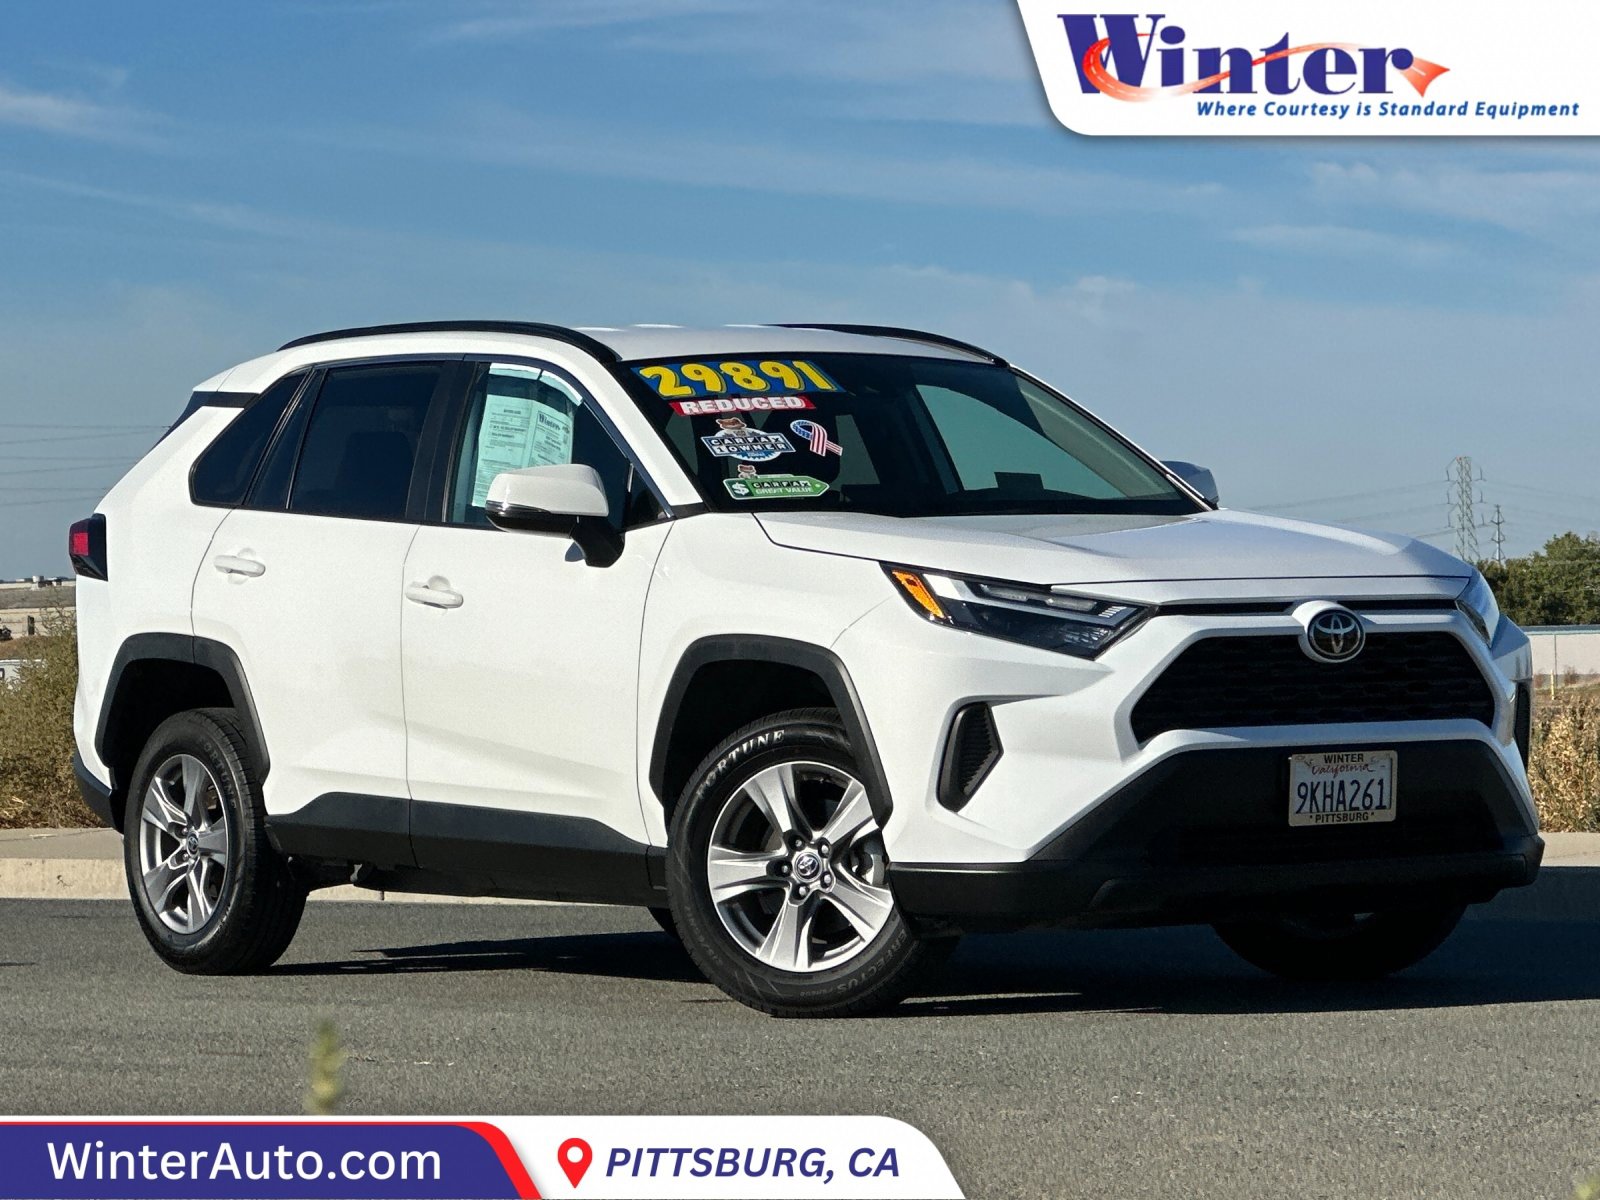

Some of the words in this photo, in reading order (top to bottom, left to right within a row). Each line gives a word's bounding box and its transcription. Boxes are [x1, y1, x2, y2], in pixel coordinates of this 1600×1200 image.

[639, 360, 838, 397] 29891
[679, 396, 807, 415] REDUCED
[711, 435, 785, 446] CARFAX
[753, 480, 811, 489] CARFAX
[784, 486, 814, 494] VALUE
[1324, 753, 1364, 764] WINTER
[1295, 778, 1387, 814] 9KHA261
[1315, 812, 1369, 823] PITTSBURG
